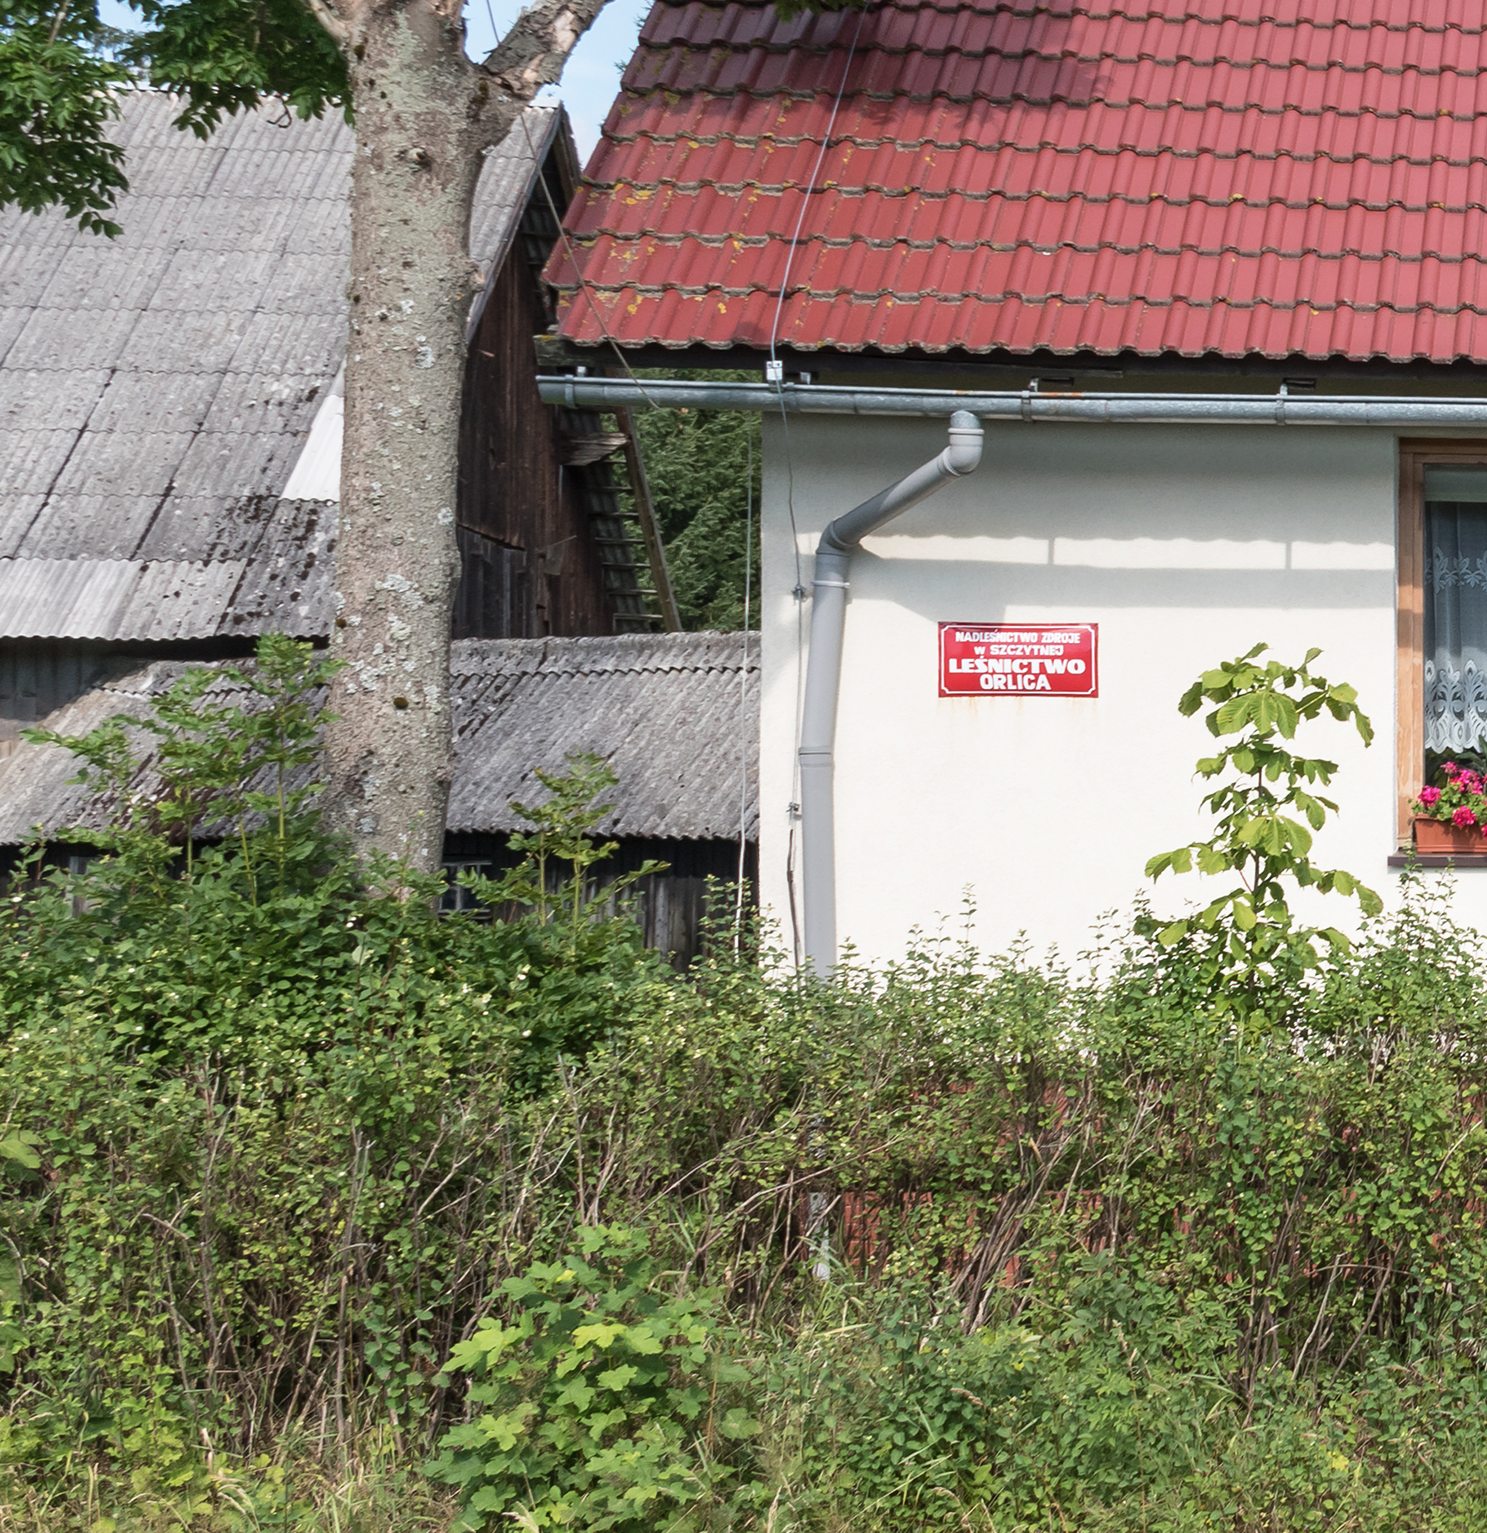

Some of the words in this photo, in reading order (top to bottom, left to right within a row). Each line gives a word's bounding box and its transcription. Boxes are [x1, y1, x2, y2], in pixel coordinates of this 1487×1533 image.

[955, 630, 1038, 643] NADLEŚNICTWO
[1041, 632, 1081, 644] ZDROJE
[990, 644, 1064, 656] SZCZYTNEJ
[949, 656, 1086, 674] LEŚNICTWO
[979, 674, 1052, 690] ORLICA
